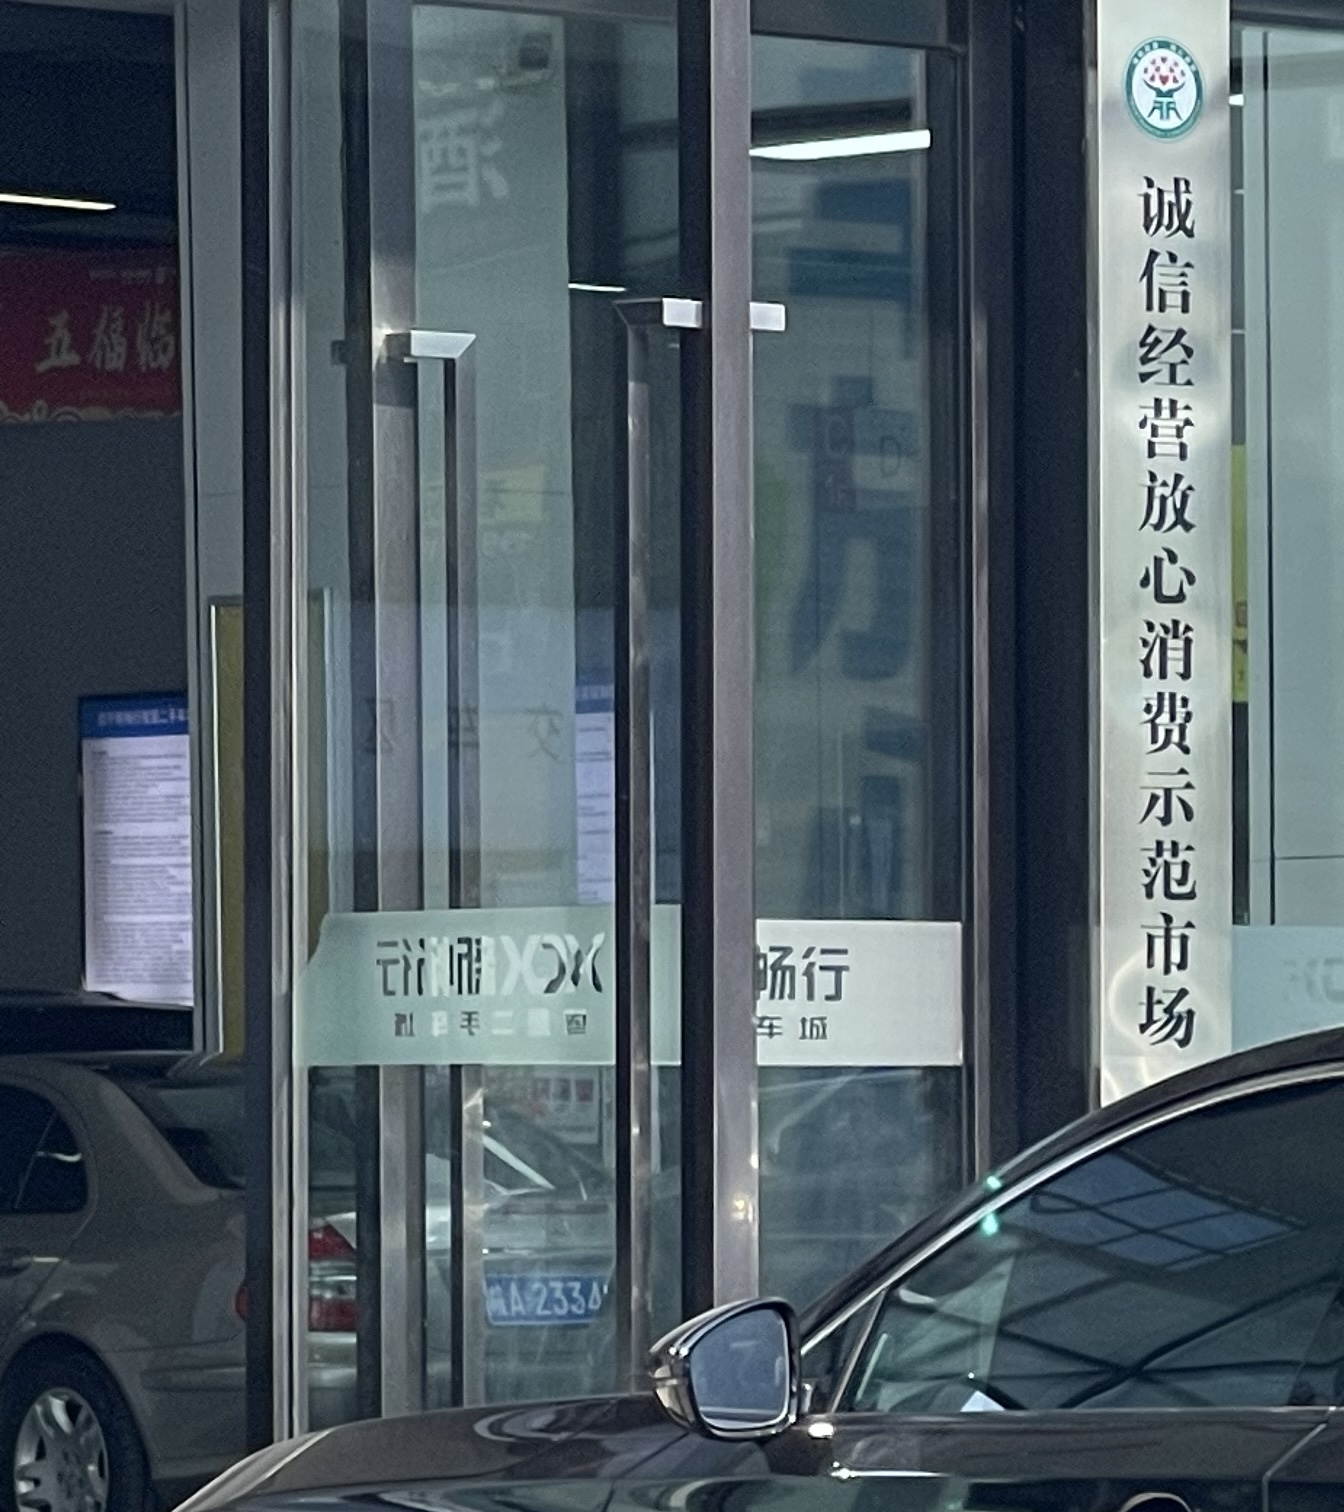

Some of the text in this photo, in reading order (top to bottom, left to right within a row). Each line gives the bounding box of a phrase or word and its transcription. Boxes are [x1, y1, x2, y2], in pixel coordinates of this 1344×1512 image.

[1137, 175, 1198, 1051] 诚信经营放心消费示范市场
